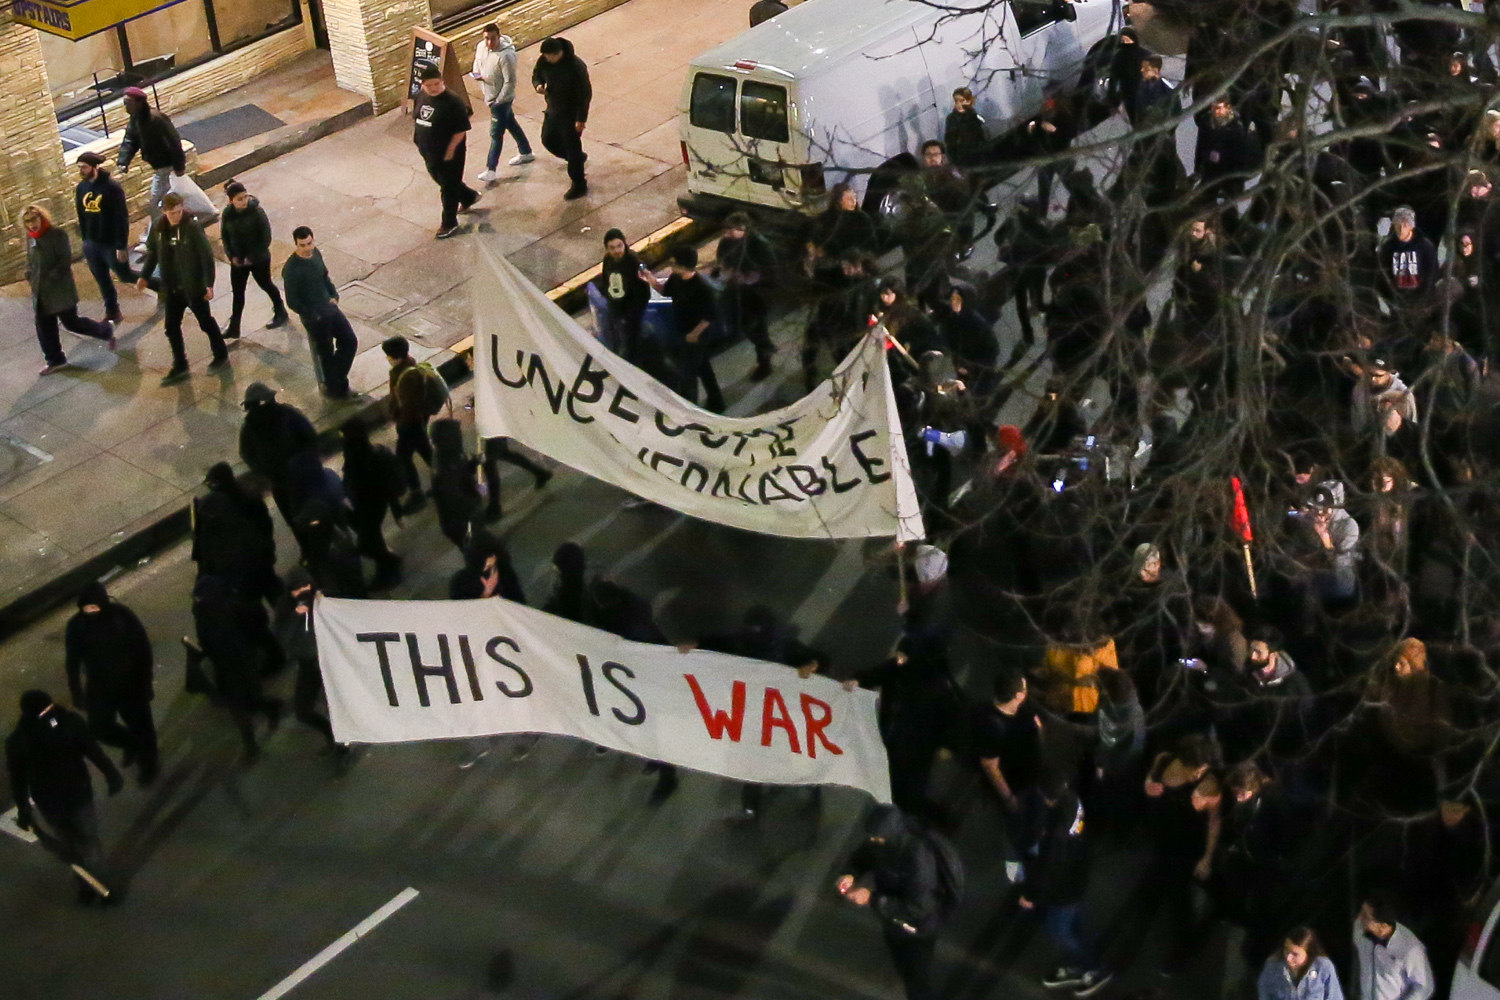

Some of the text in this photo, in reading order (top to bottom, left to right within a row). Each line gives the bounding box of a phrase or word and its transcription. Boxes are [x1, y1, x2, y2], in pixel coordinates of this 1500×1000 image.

[356, 631, 843, 760] THIS IS WAR
